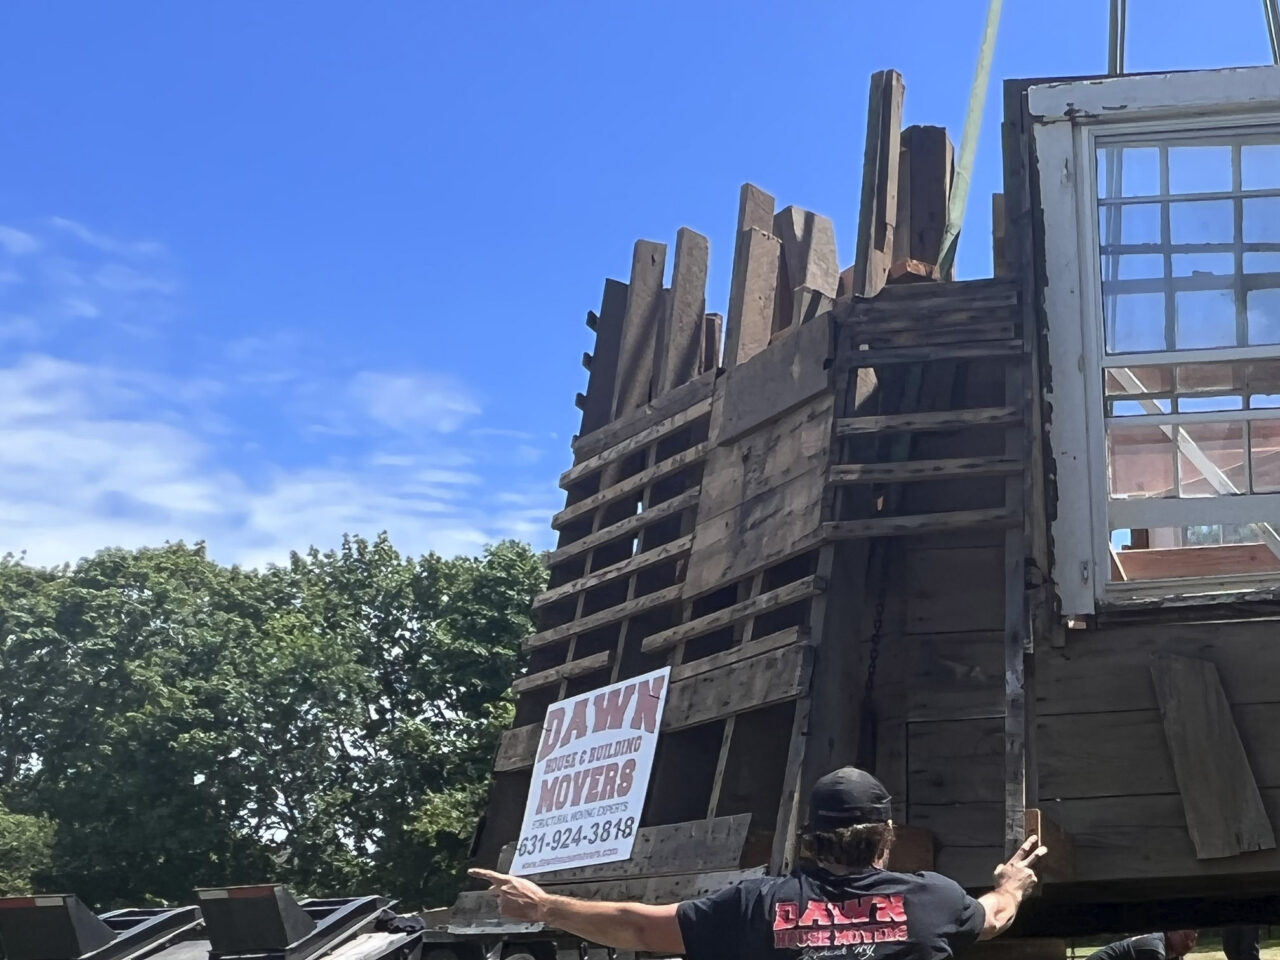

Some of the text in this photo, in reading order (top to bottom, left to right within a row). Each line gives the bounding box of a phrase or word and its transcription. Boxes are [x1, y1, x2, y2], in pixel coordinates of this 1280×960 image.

[536, 675, 666, 764] DAWN
[544, 752, 576, 775] HOUSE
[587, 736, 642, 764] BUILDING
[535, 758, 637, 815] MOVERS
[518, 816, 635, 857] 631-924-3818
[773, 894, 908, 930] DAWN
[774, 928, 831, 949] HOUSE
